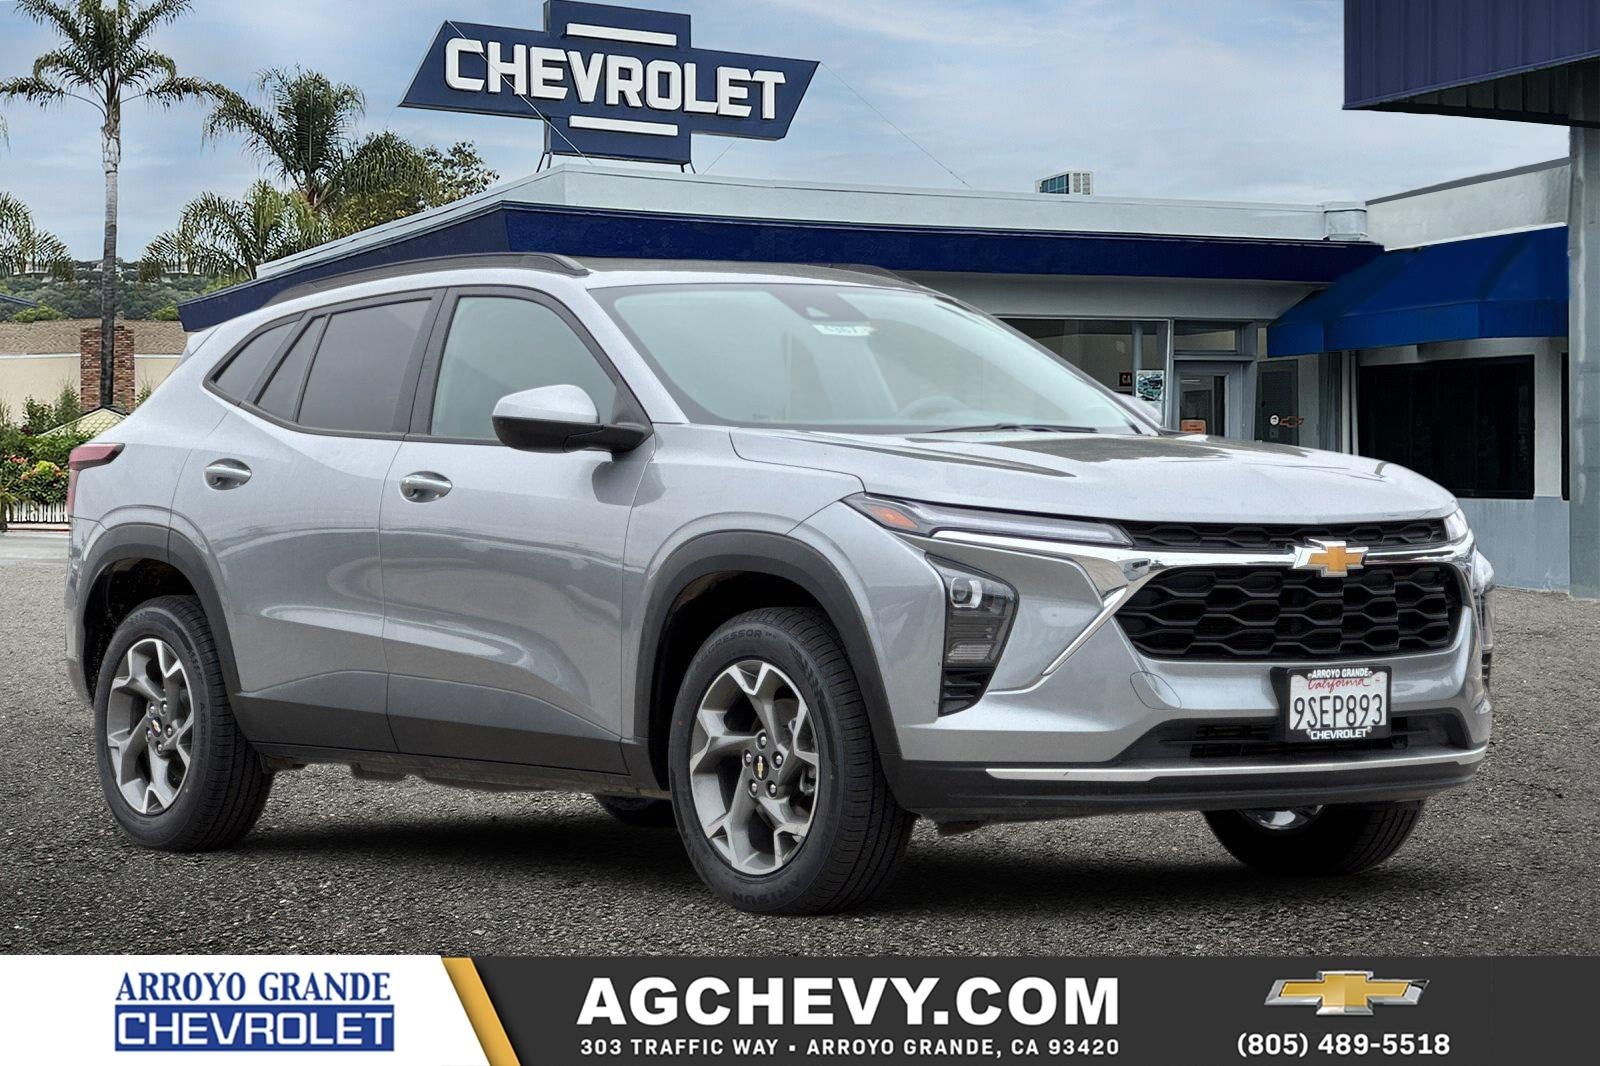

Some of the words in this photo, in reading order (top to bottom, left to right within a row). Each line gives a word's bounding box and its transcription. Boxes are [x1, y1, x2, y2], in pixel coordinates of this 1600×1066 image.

[445, 37, 786, 120] CHEVROLET
[1311, 669, 1340, 679] ARROYO
[1341, 667, 1370, 678] GRANDE
[1294, 693, 1383, 730] 9SEP893
[1310, 728, 1368, 740] CHEVROLET
